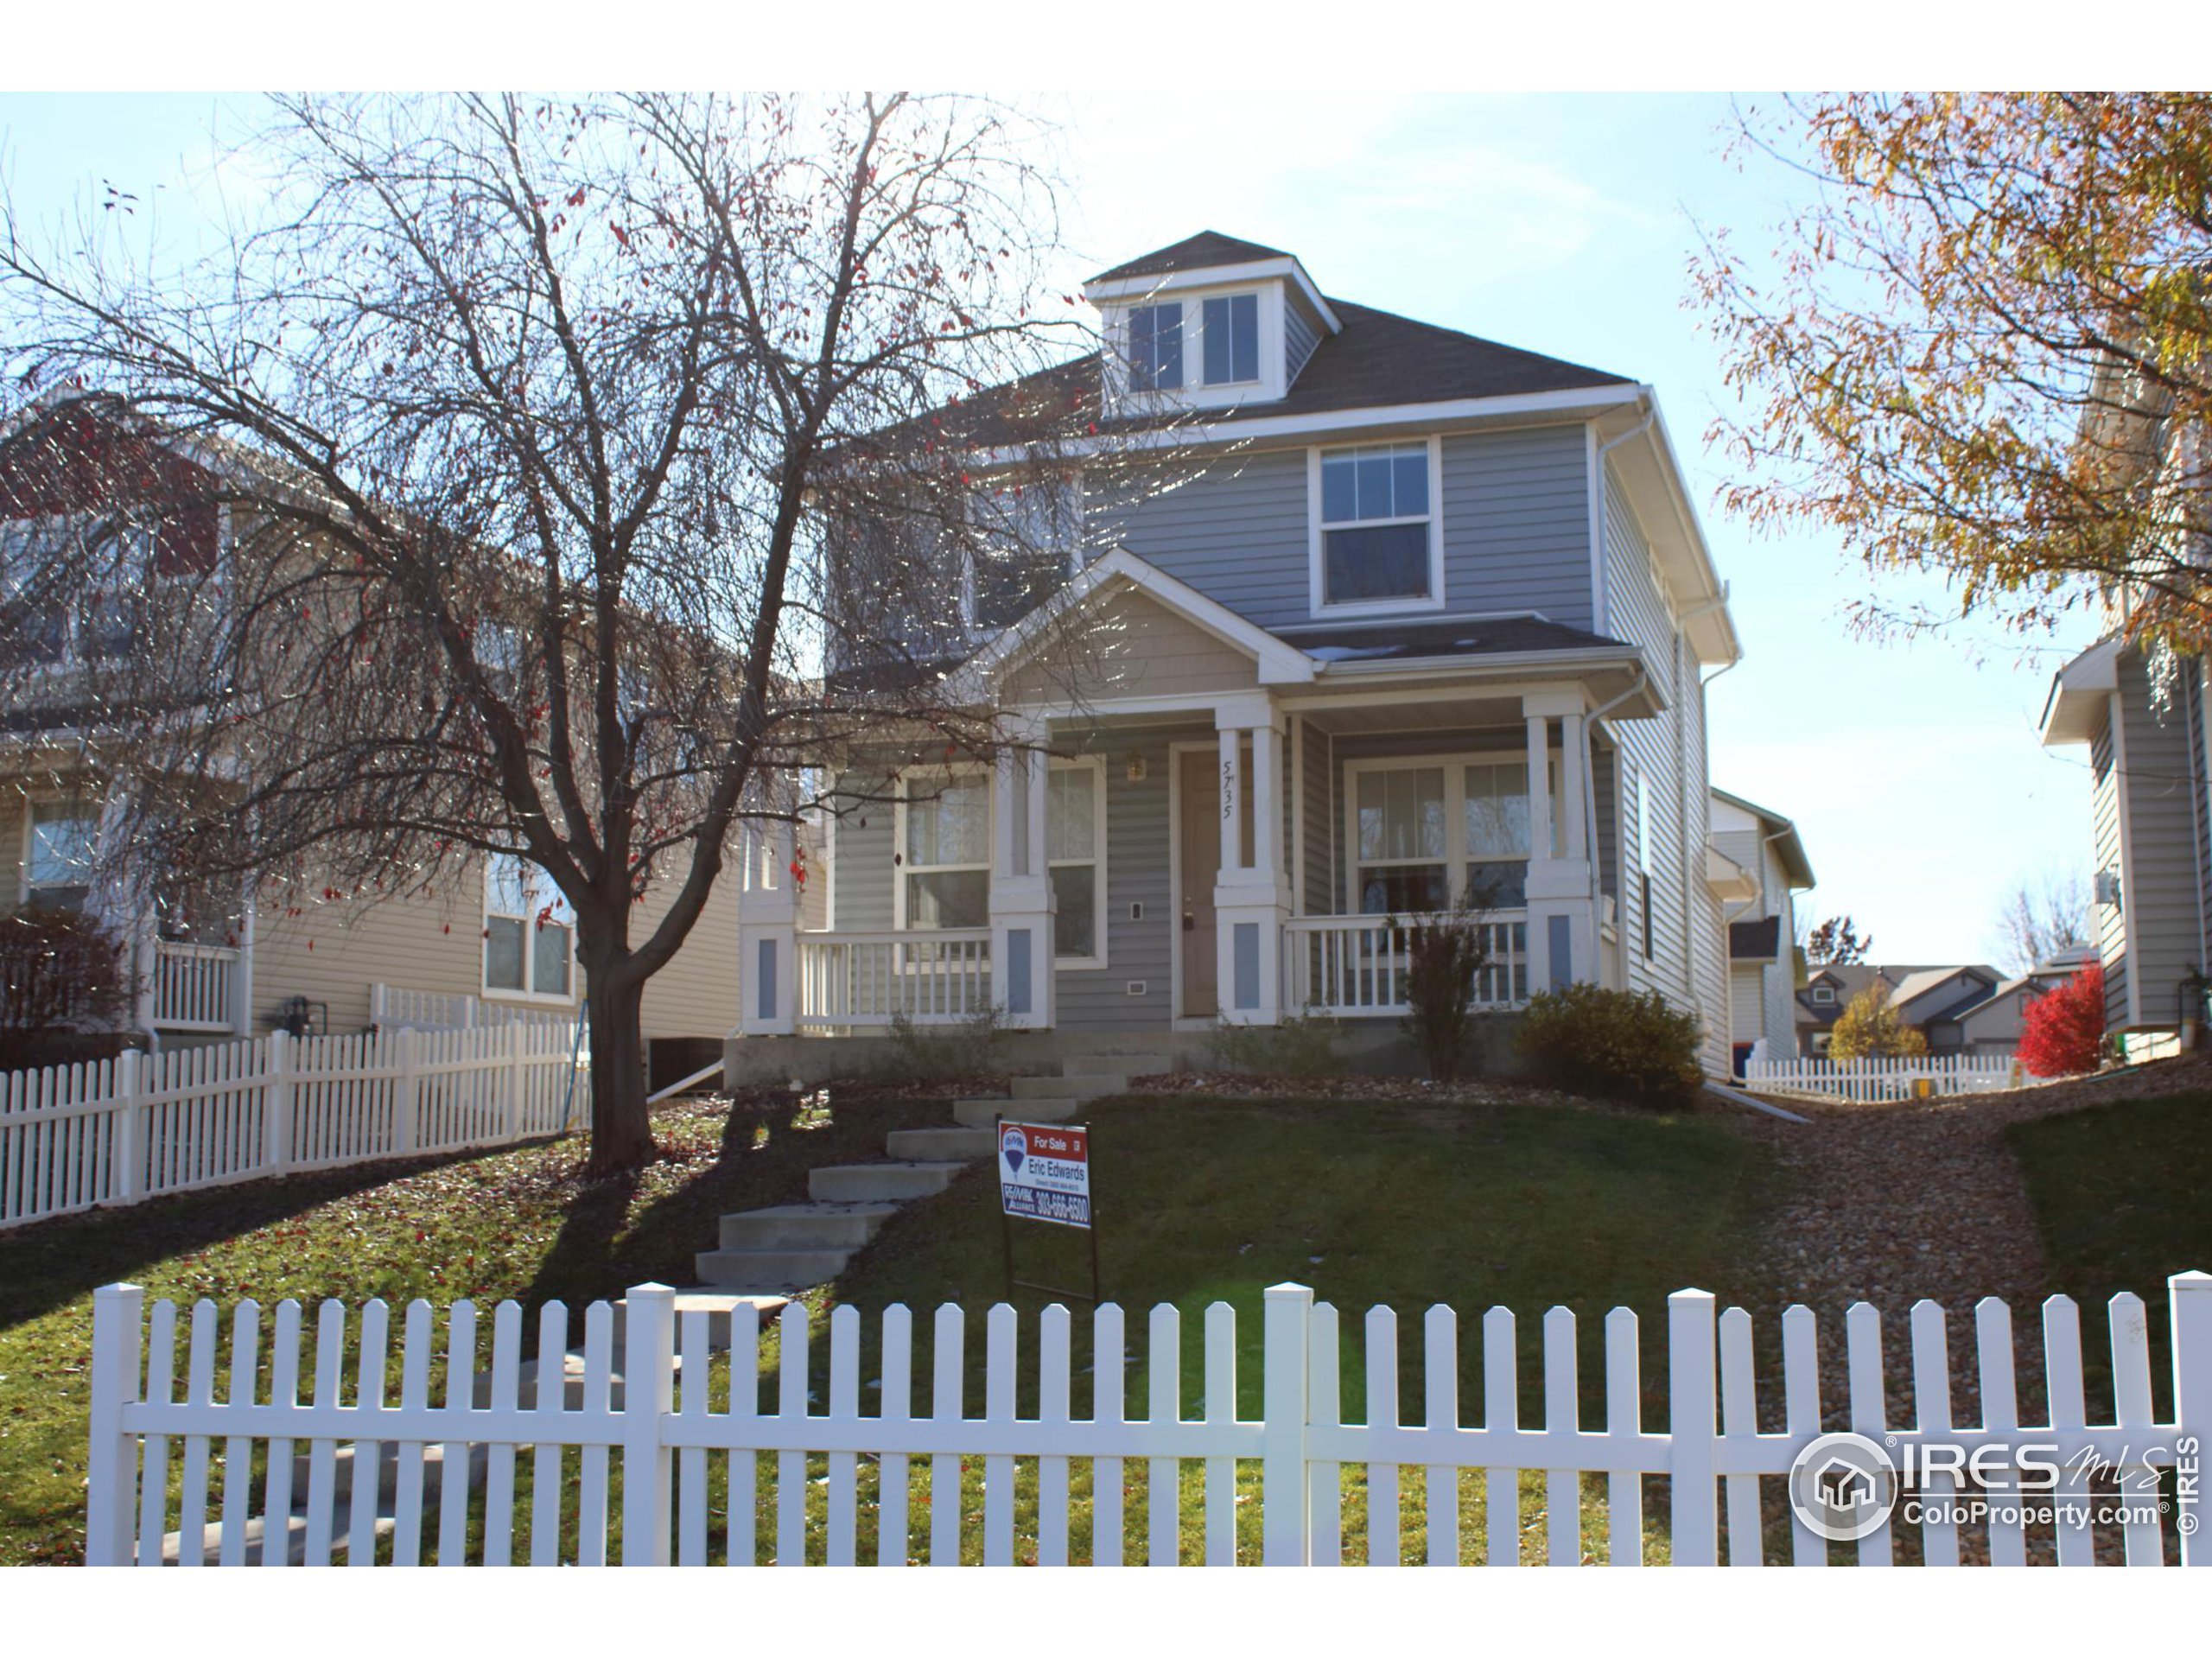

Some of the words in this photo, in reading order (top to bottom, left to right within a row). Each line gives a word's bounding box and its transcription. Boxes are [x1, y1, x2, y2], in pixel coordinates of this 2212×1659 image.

[1223, 760, 1234, 820] 5735
[1034, 1136, 1047, 1148] For
[1049, 1137, 1067, 1151] Sale
[1029, 1159, 1046, 1176] Eric
[1047, 1160, 1085, 1181] Edwards
